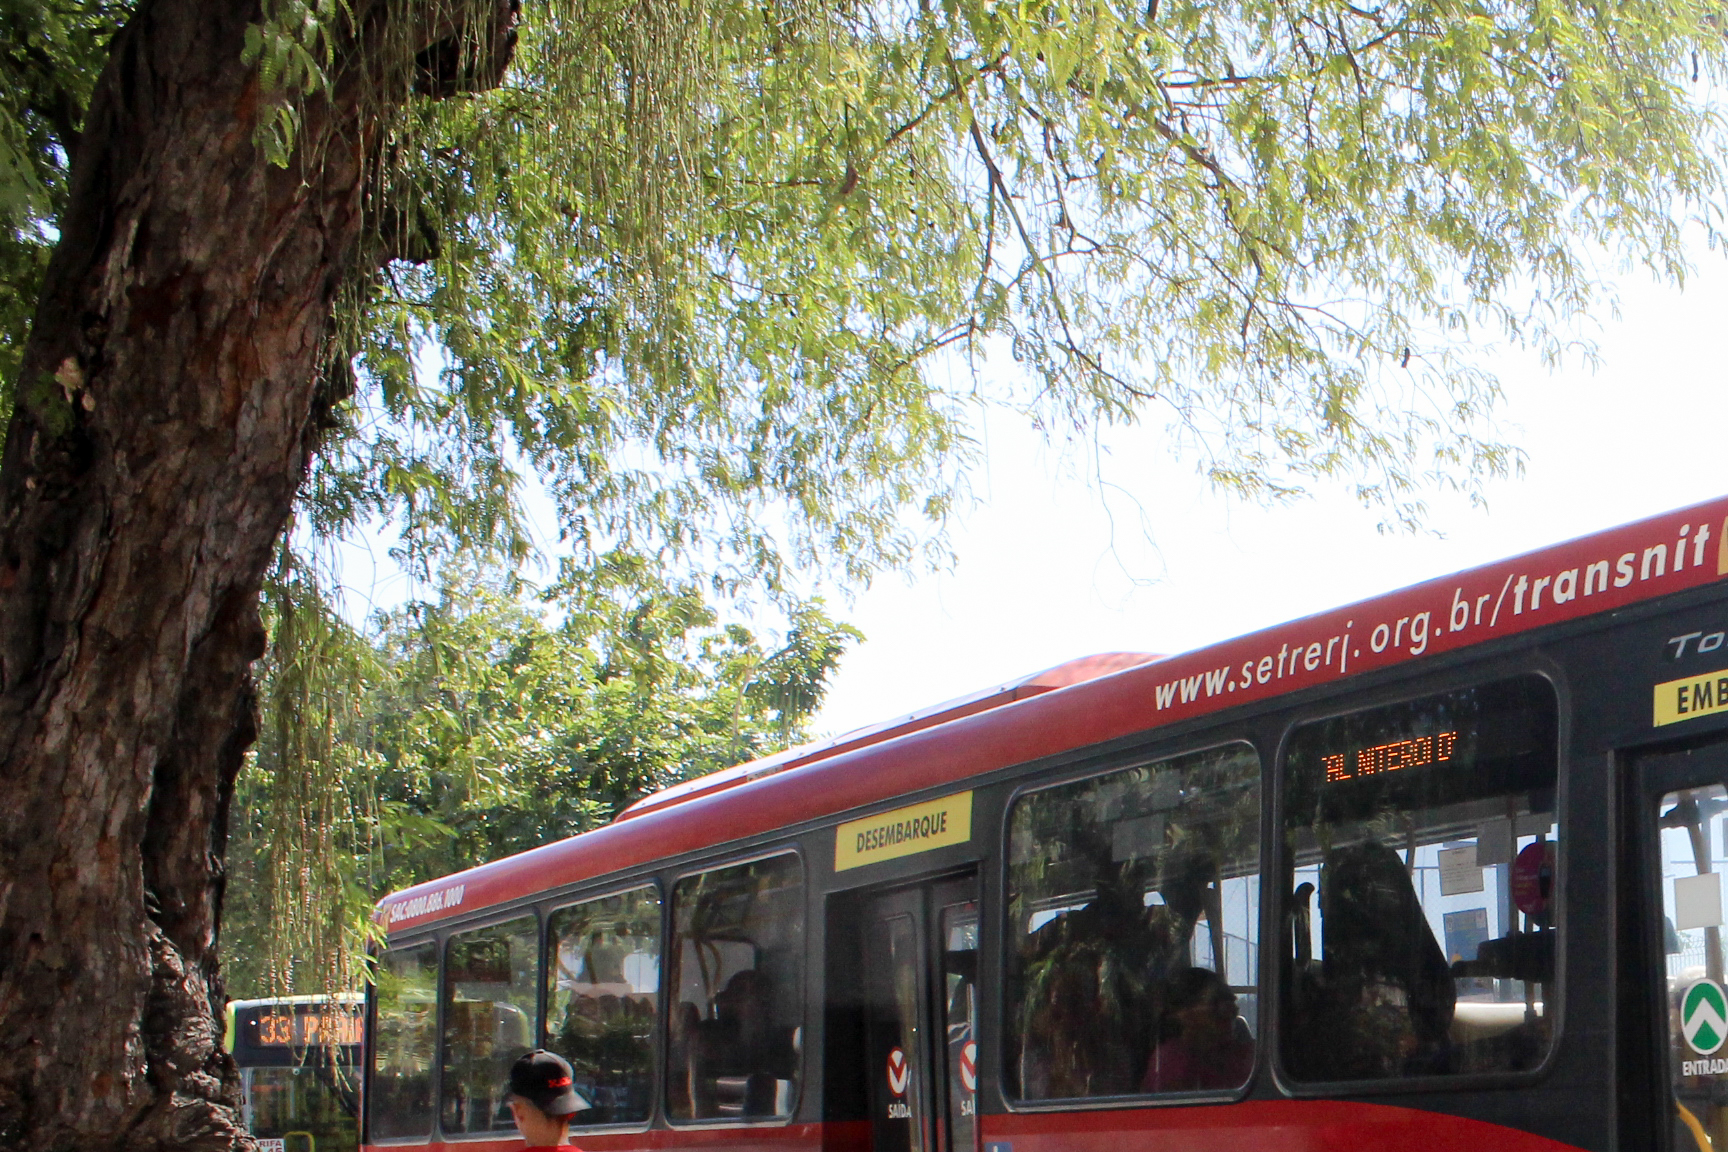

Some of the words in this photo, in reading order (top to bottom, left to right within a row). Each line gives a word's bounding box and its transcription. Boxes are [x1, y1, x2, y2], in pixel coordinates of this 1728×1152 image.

[1154, 522, 1711, 711] www.setrerj.org.br/transnit
[856, 811, 948, 853] DESEMBARQUE
[888, 1100, 912, 1119] SAÍDA
